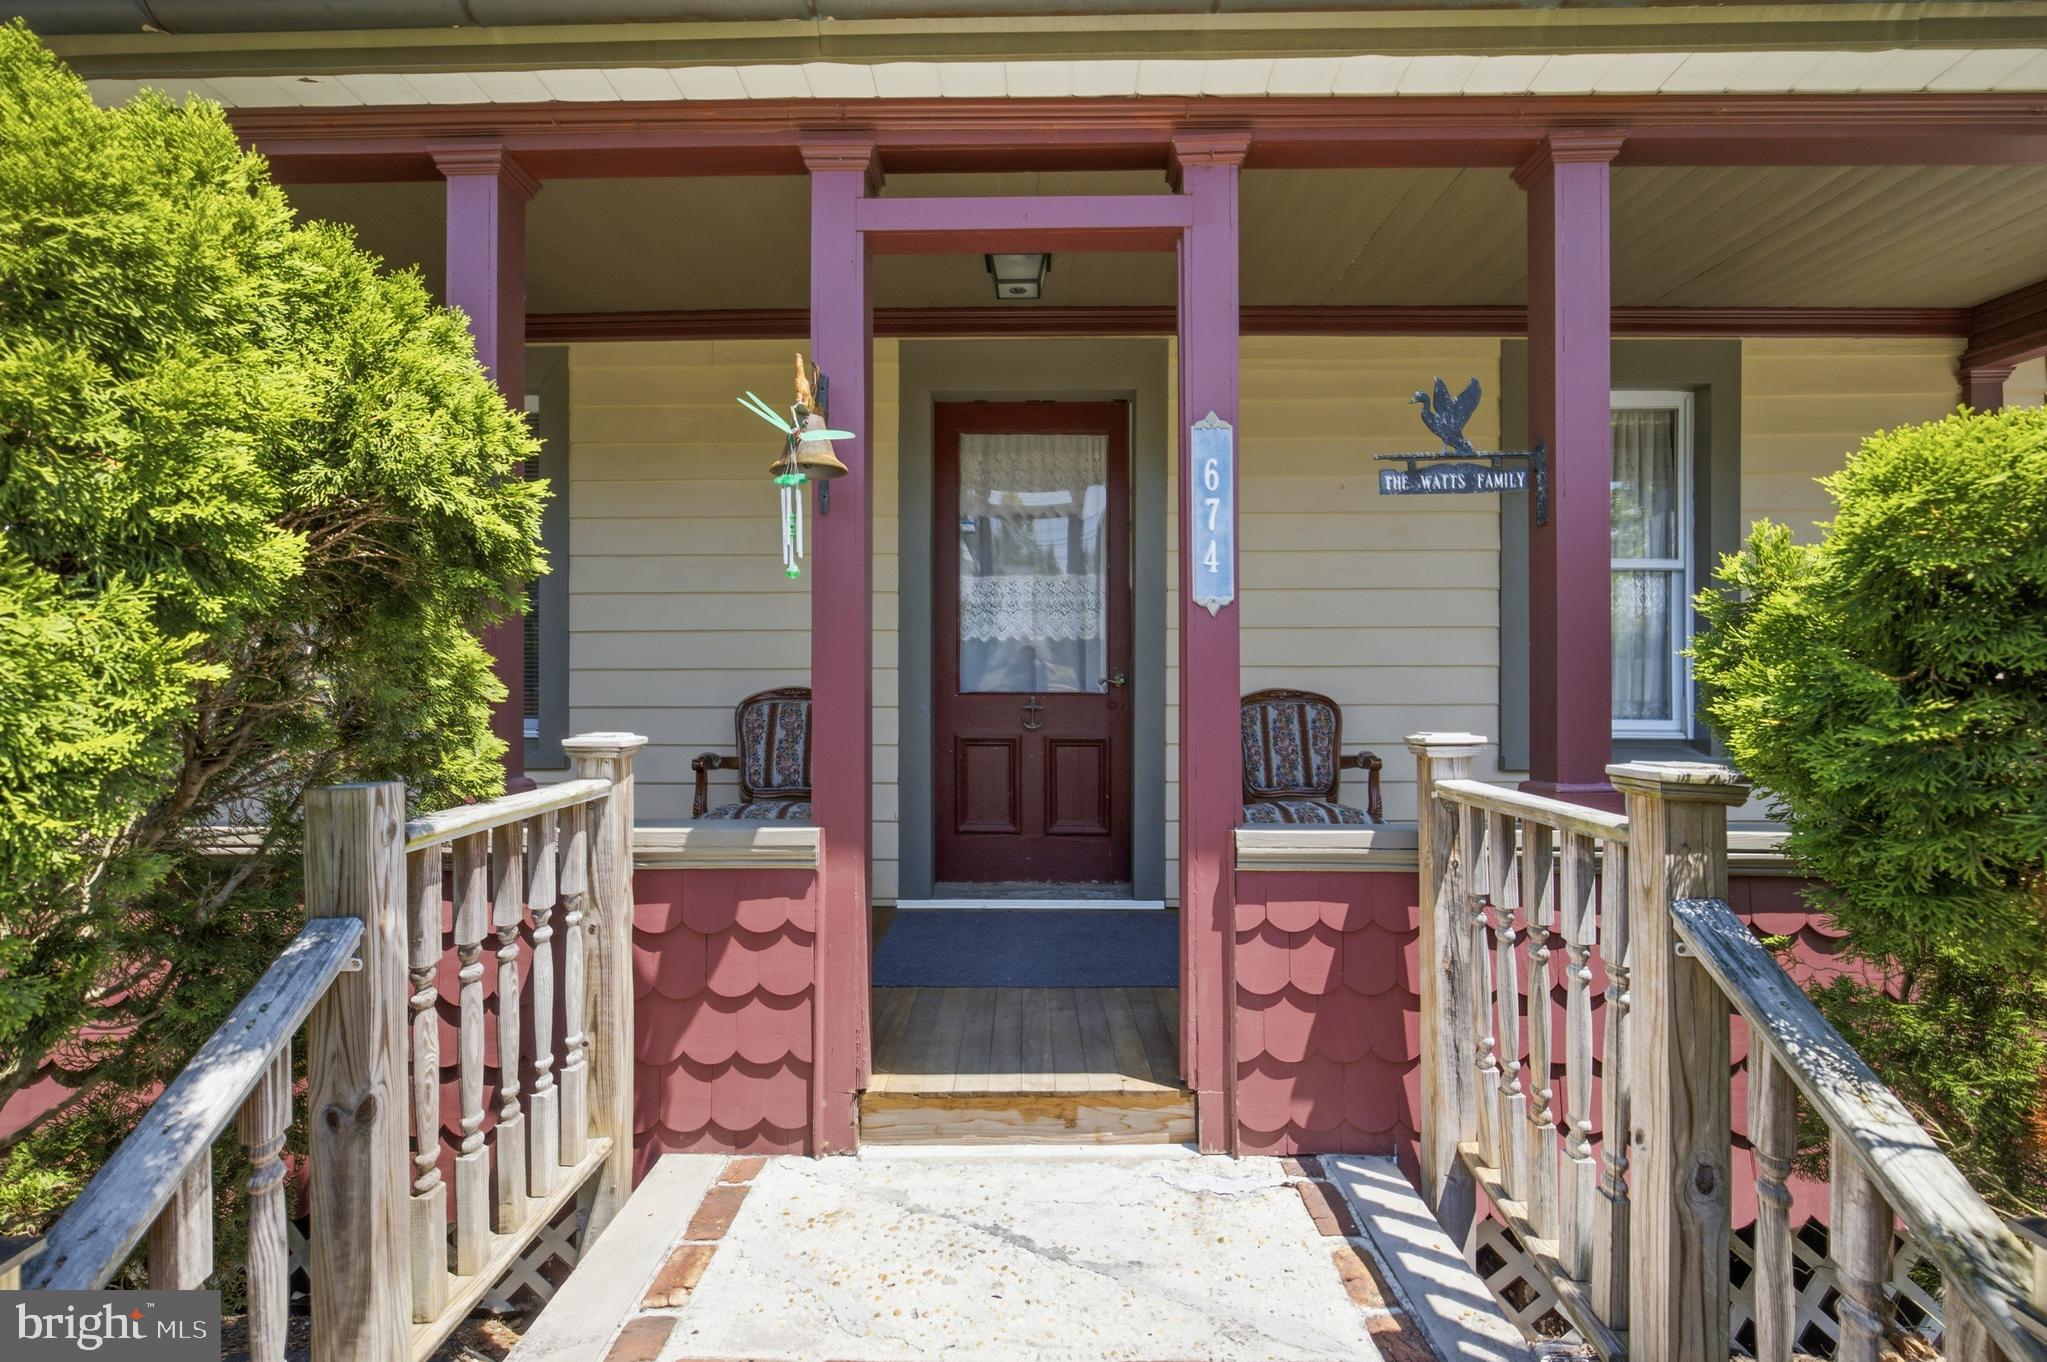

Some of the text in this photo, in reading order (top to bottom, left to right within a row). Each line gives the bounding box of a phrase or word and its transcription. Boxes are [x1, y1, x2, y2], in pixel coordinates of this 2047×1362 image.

[1384, 471, 1526, 491] THE WATTS FAMILY
[1203, 457, 1221, 574] 674
